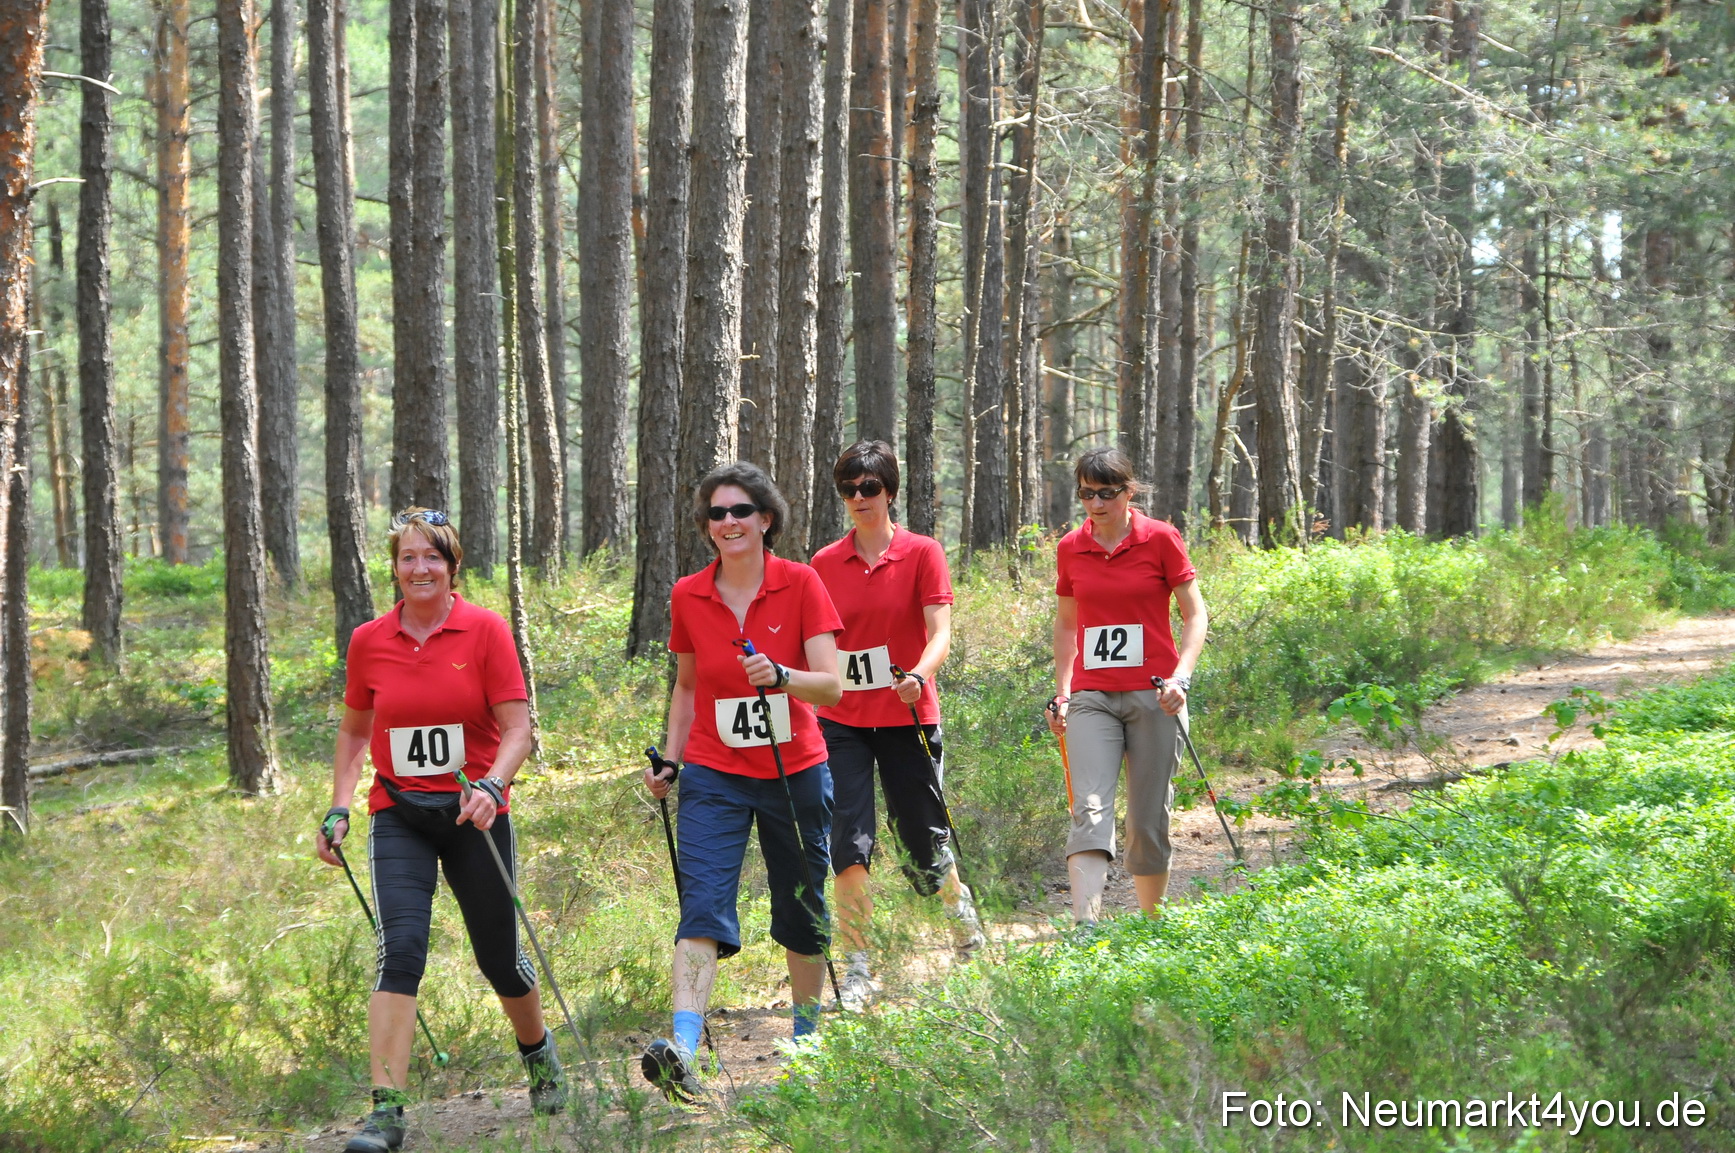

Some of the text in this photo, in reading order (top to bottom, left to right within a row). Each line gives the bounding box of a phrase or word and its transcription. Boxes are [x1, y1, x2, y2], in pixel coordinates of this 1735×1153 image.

[1093, 627, 1128, 662] 42
[845, 653, 873, 686] 41
[732, 700, 772, 741] 43
[407, 727, 450, 767] 40
